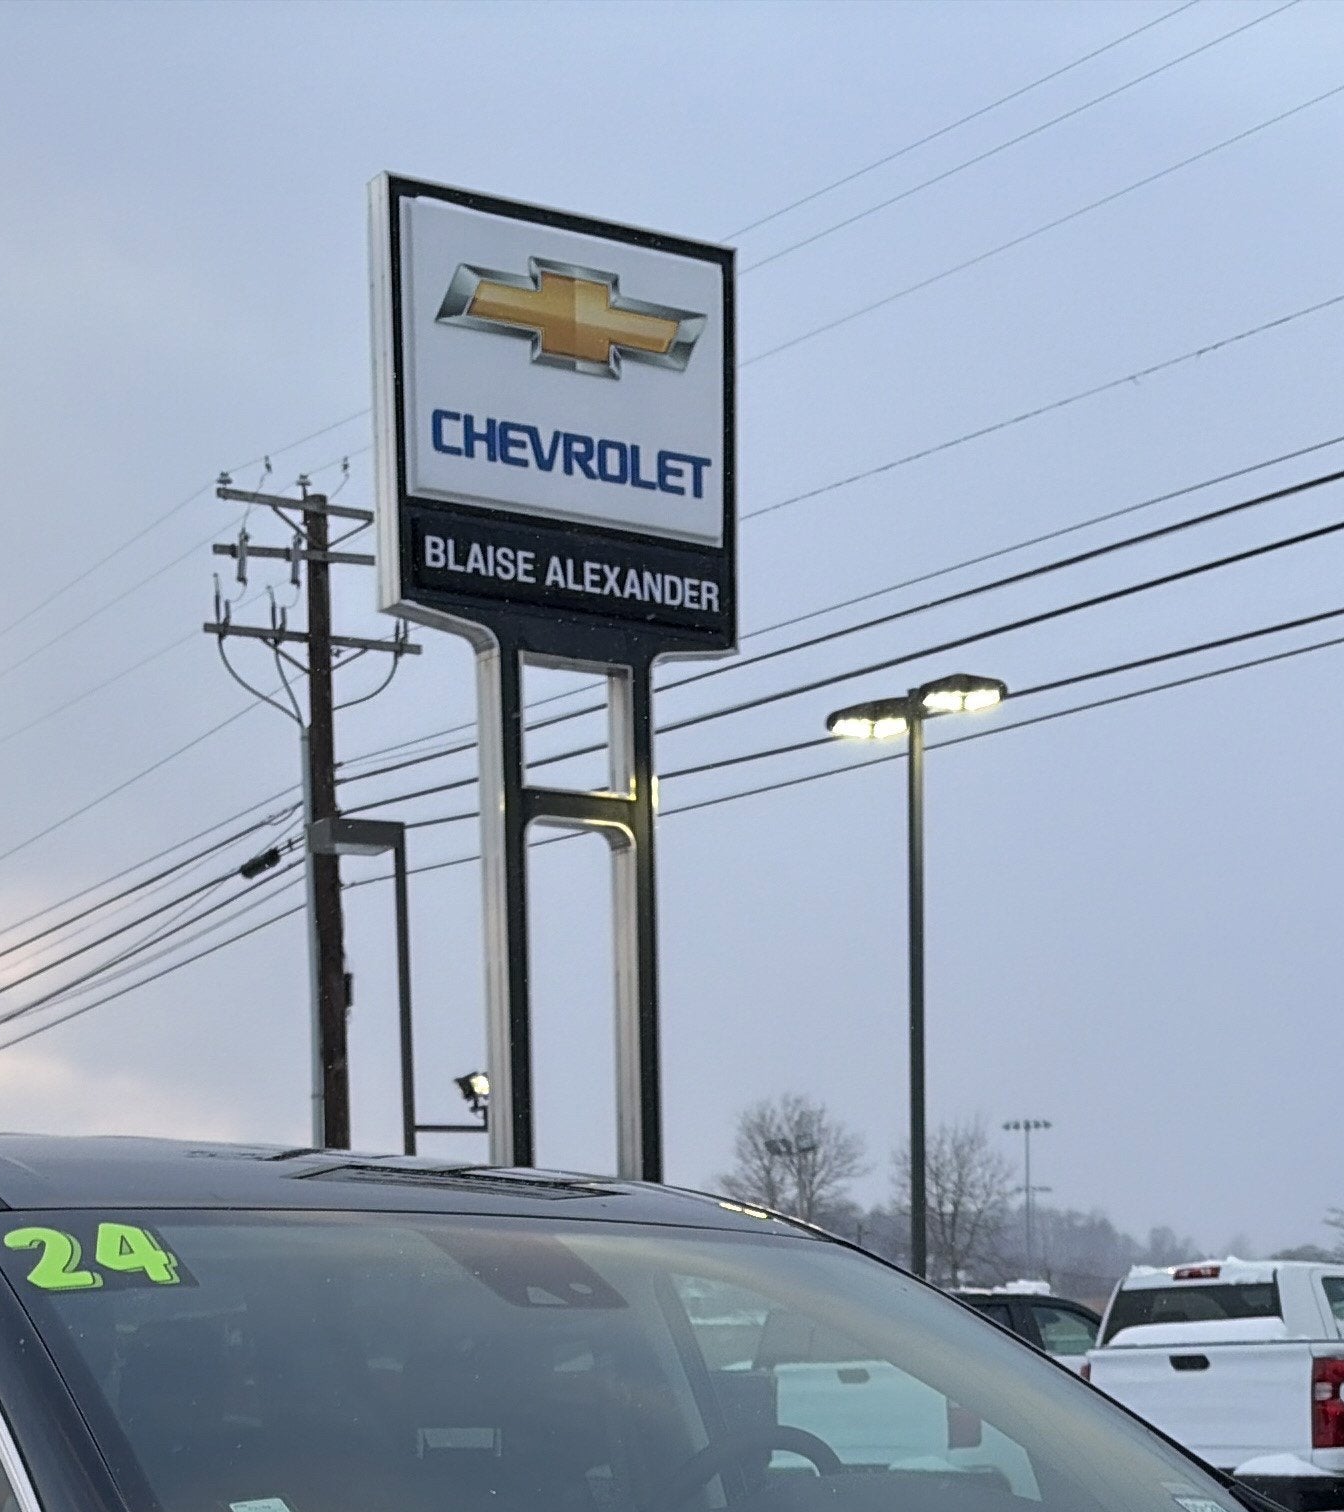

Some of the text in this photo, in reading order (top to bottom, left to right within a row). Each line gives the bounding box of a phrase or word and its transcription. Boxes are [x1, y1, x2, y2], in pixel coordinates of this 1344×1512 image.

[431, 408, 712, 499] CHEVROLET
[424, 535, 720, 613] BLAISE ALEXANDER
[3, 1222, 181, 1291] 24
